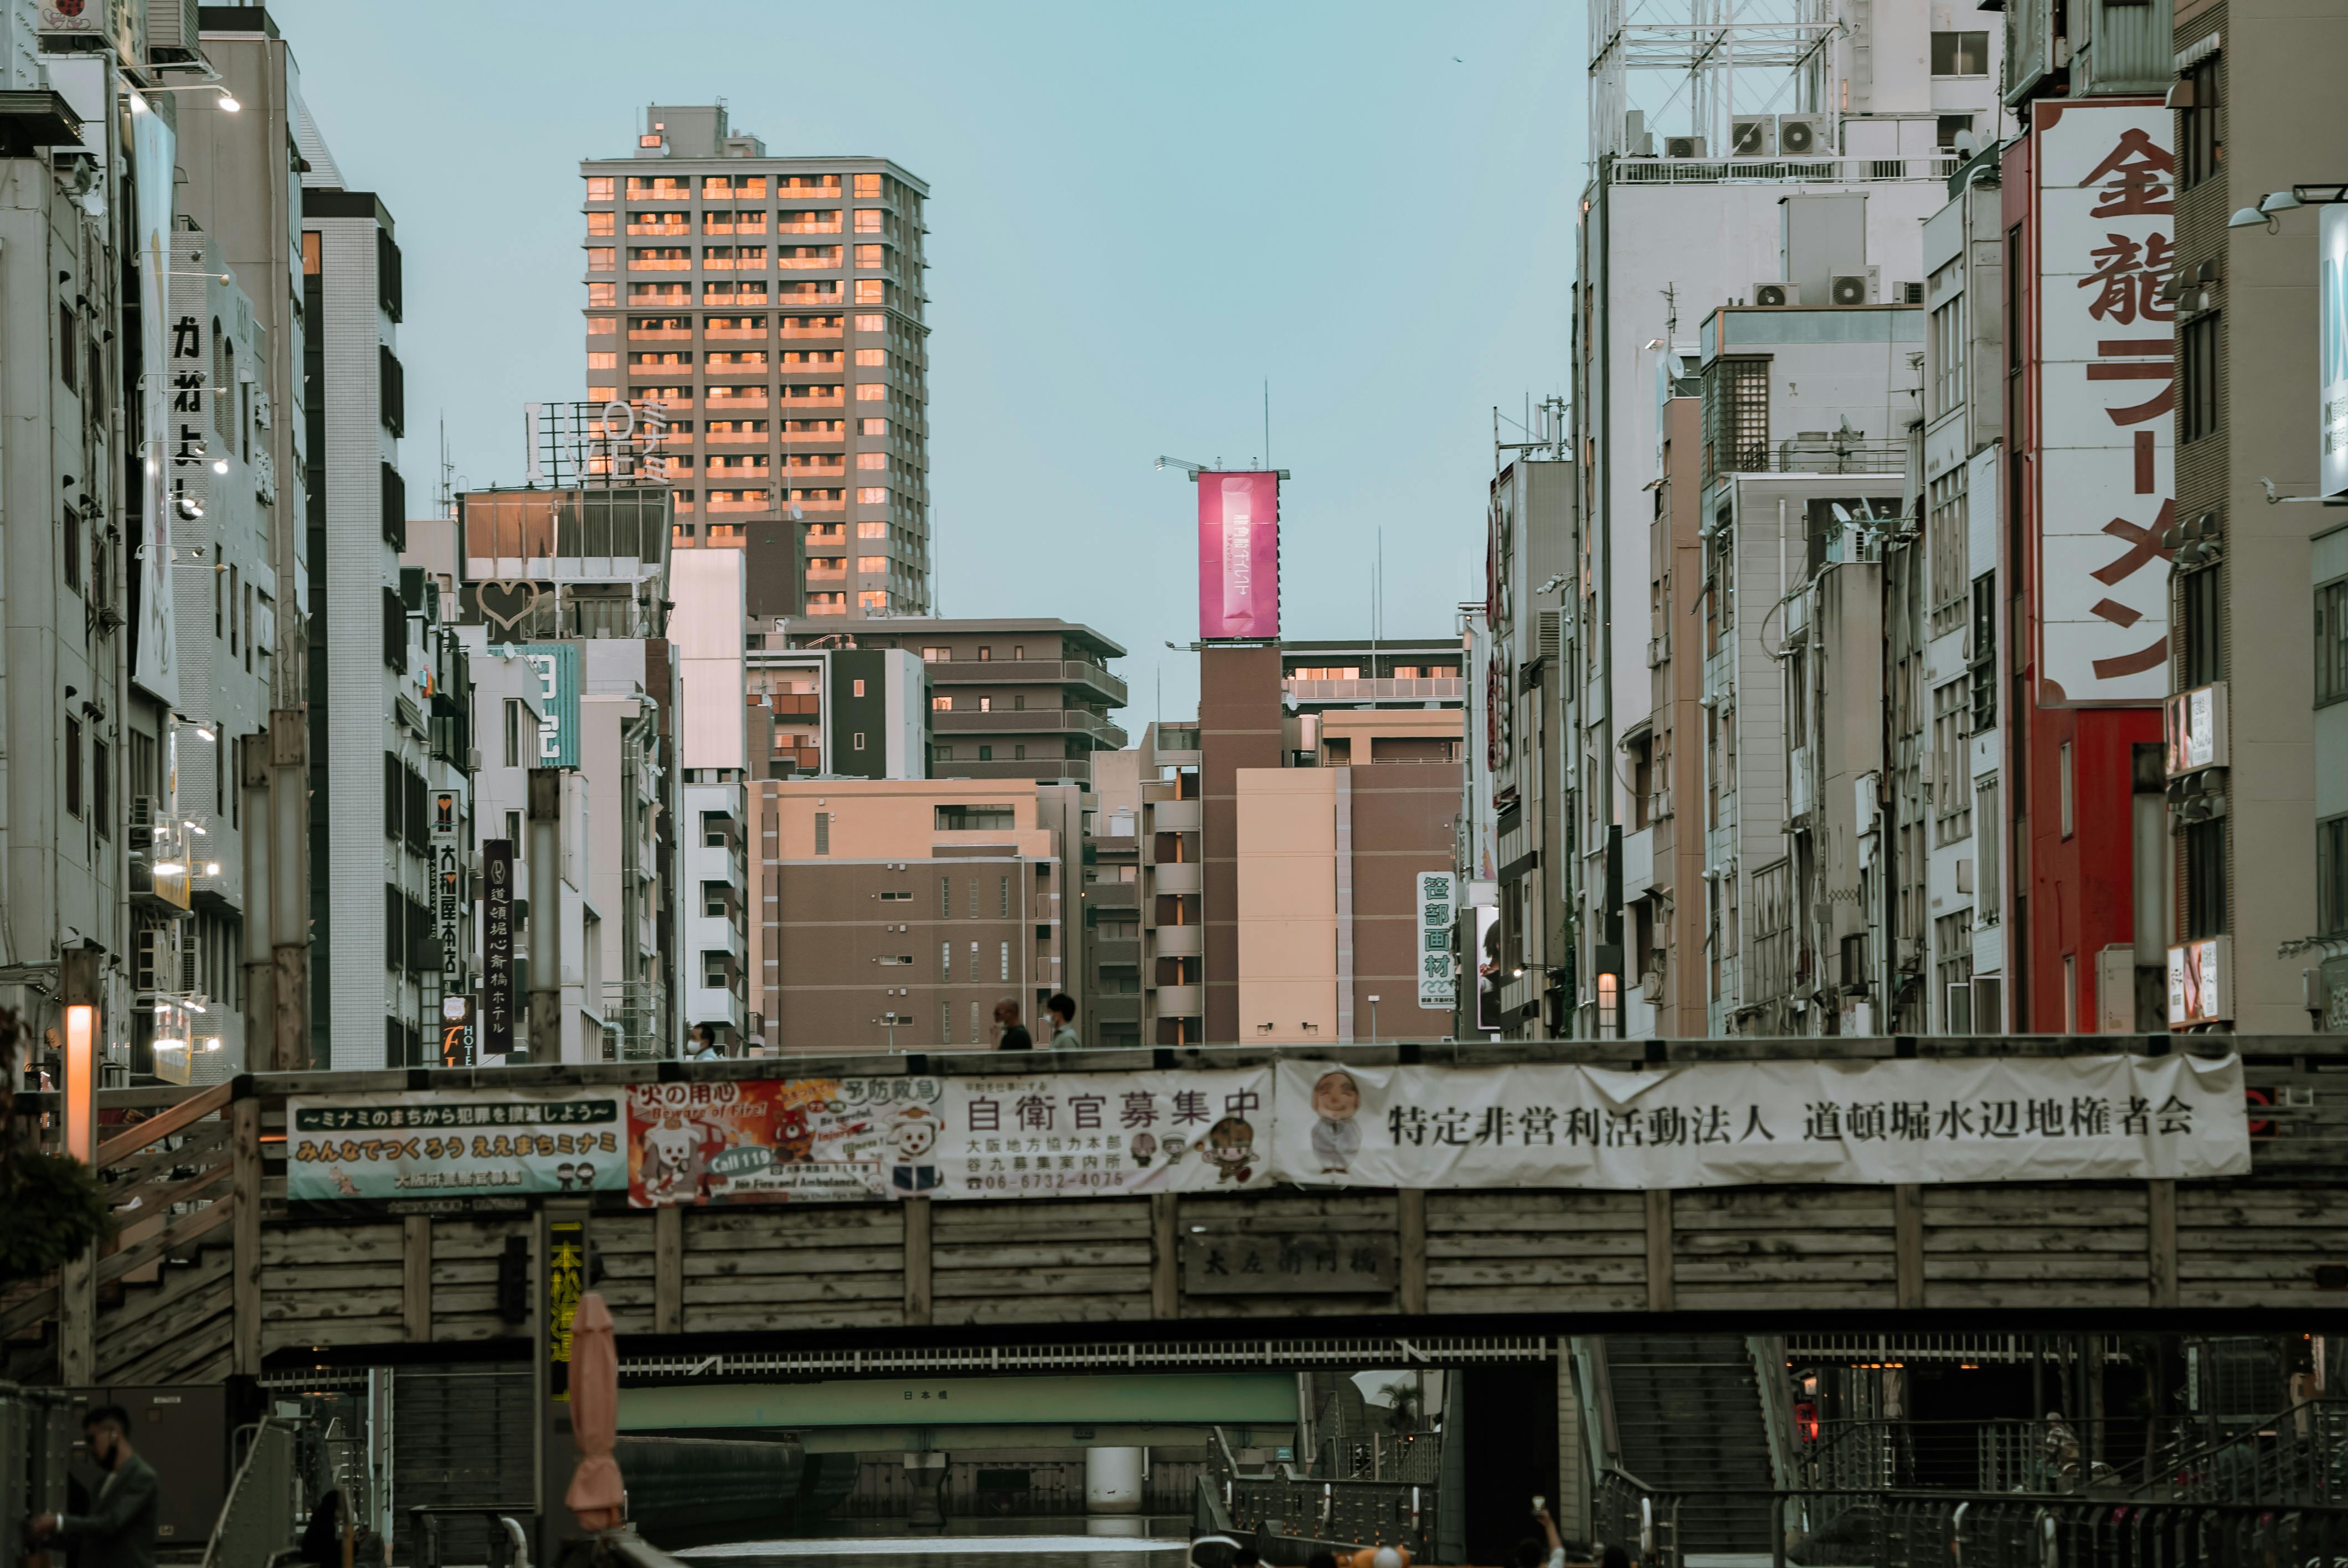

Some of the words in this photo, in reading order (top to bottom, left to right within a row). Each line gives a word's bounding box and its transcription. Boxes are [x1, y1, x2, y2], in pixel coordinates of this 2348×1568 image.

[2078, 128, 2174, 679] 金龍ラーメン
[172, 316, 202, 520] かねよし
[1424, 877, 1450, 978] 笹部画材
[641, 1082, 737, 1106] 火の用心
[845, 1079, 935, 1100] 予防救急
[652, 1107, 706, 1120] Beware
[968, 1087, 1259, 1132] 自衛官募集中
[1388, 1103, 1775, 1147] 特定非営利活動法人
[1803, 1094, 2195, 1142] 道頓堀水辺地権者会
[296, 1136, 465, 1162] みんなでつくろう
[471, 1131, 617, 1158] ええまちミナミ
[966, 1134, 1122, 1154] 大阪地方協力本部
[711, 1154, 739, 1173] Call
[741, 1150, 771, 1168] 119
[904, 1390, 948, 1400] 日本橋
